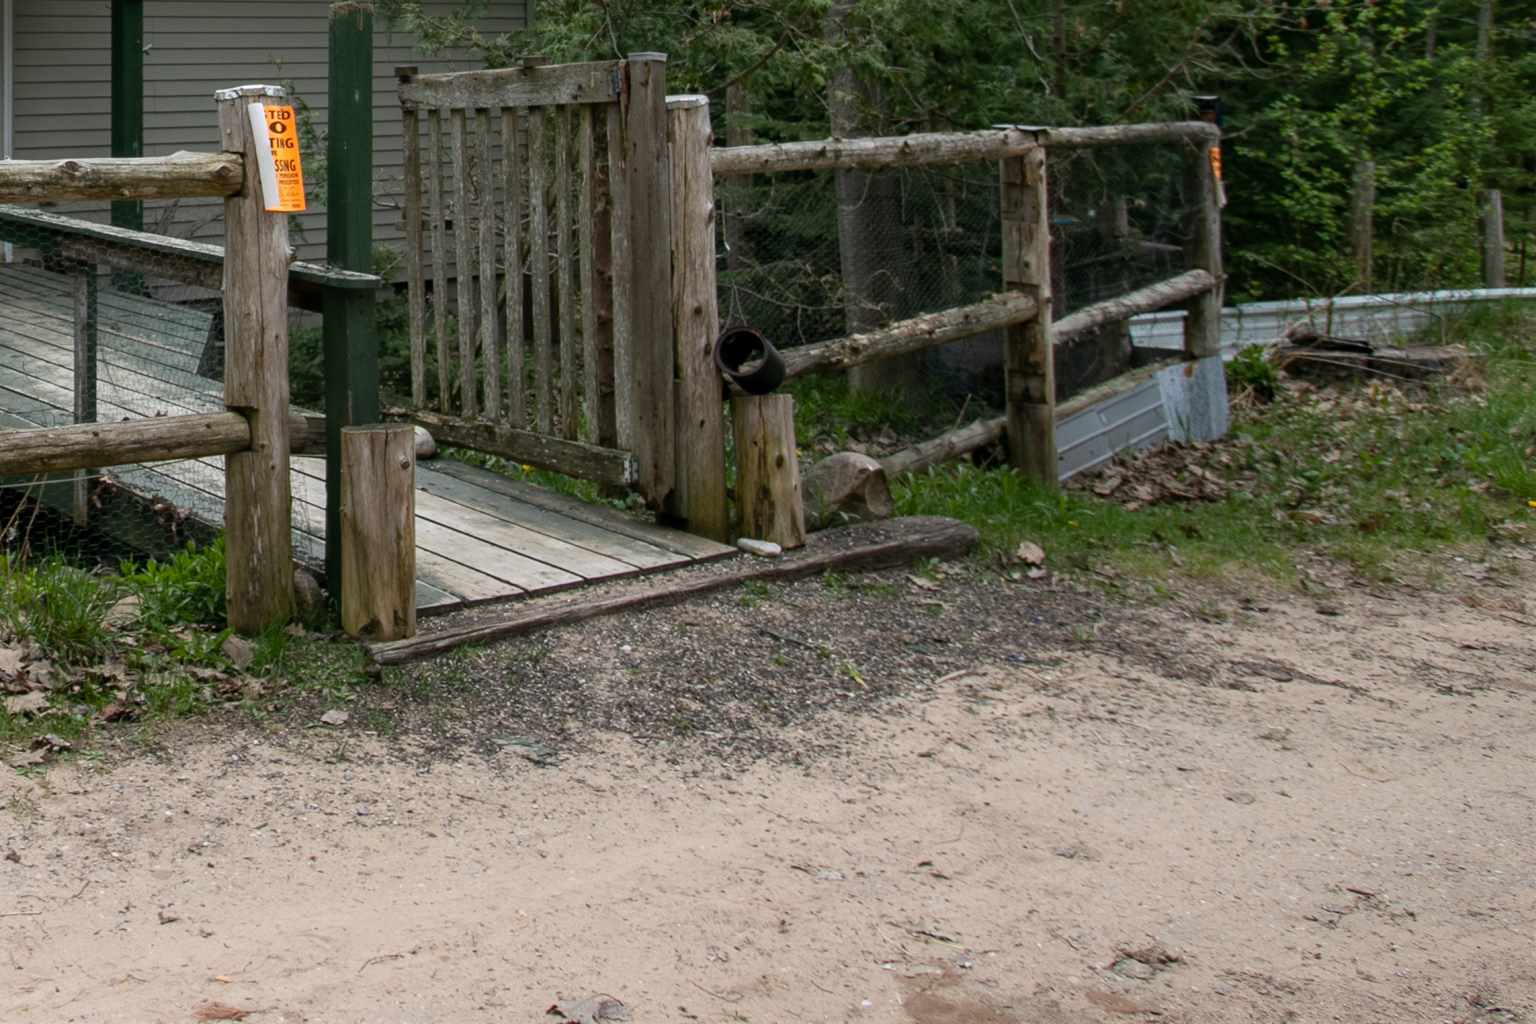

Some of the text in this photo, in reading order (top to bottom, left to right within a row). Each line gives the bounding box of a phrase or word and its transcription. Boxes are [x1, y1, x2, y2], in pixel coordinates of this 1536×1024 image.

[265, 109, 291, 121] TED
[268, 121, 287, 134] O
[269, 137, 294, 149] TING
